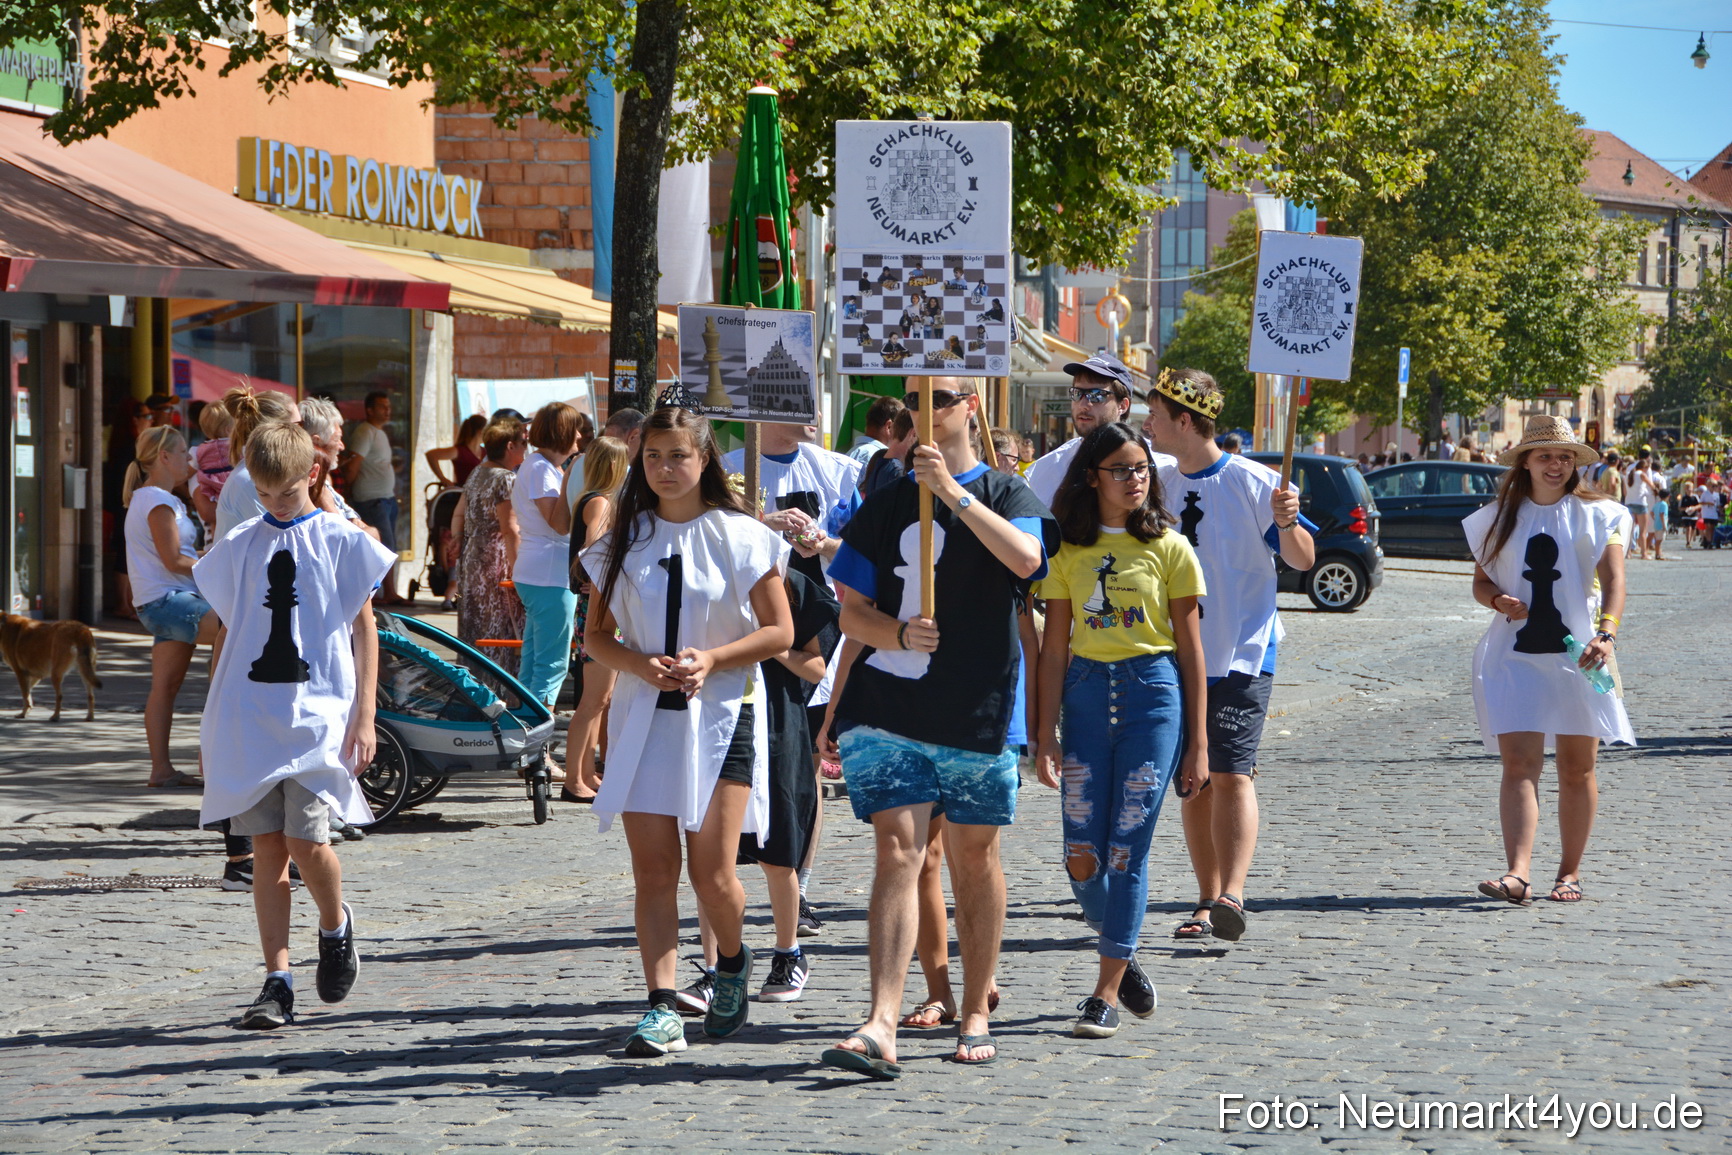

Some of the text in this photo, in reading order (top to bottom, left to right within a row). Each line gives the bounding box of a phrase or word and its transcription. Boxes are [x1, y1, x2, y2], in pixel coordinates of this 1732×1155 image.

[869, 124, 974, 168] SCHACHKLUB
[254, 137, 484, 239] LEDER ROMSTÖCK
[866, 196, 978, 245] NEUMARKT E.V.
[1262, 256, 1351, 294] SCHACHKLUB
[717, 316, 777, 329] Chefstrategen
[1257, 311, 1351, 355] NEUMARKT E.V.
[1400, 352, 1408, 379] P
[453, 737, 494, 748] Qeridoo
